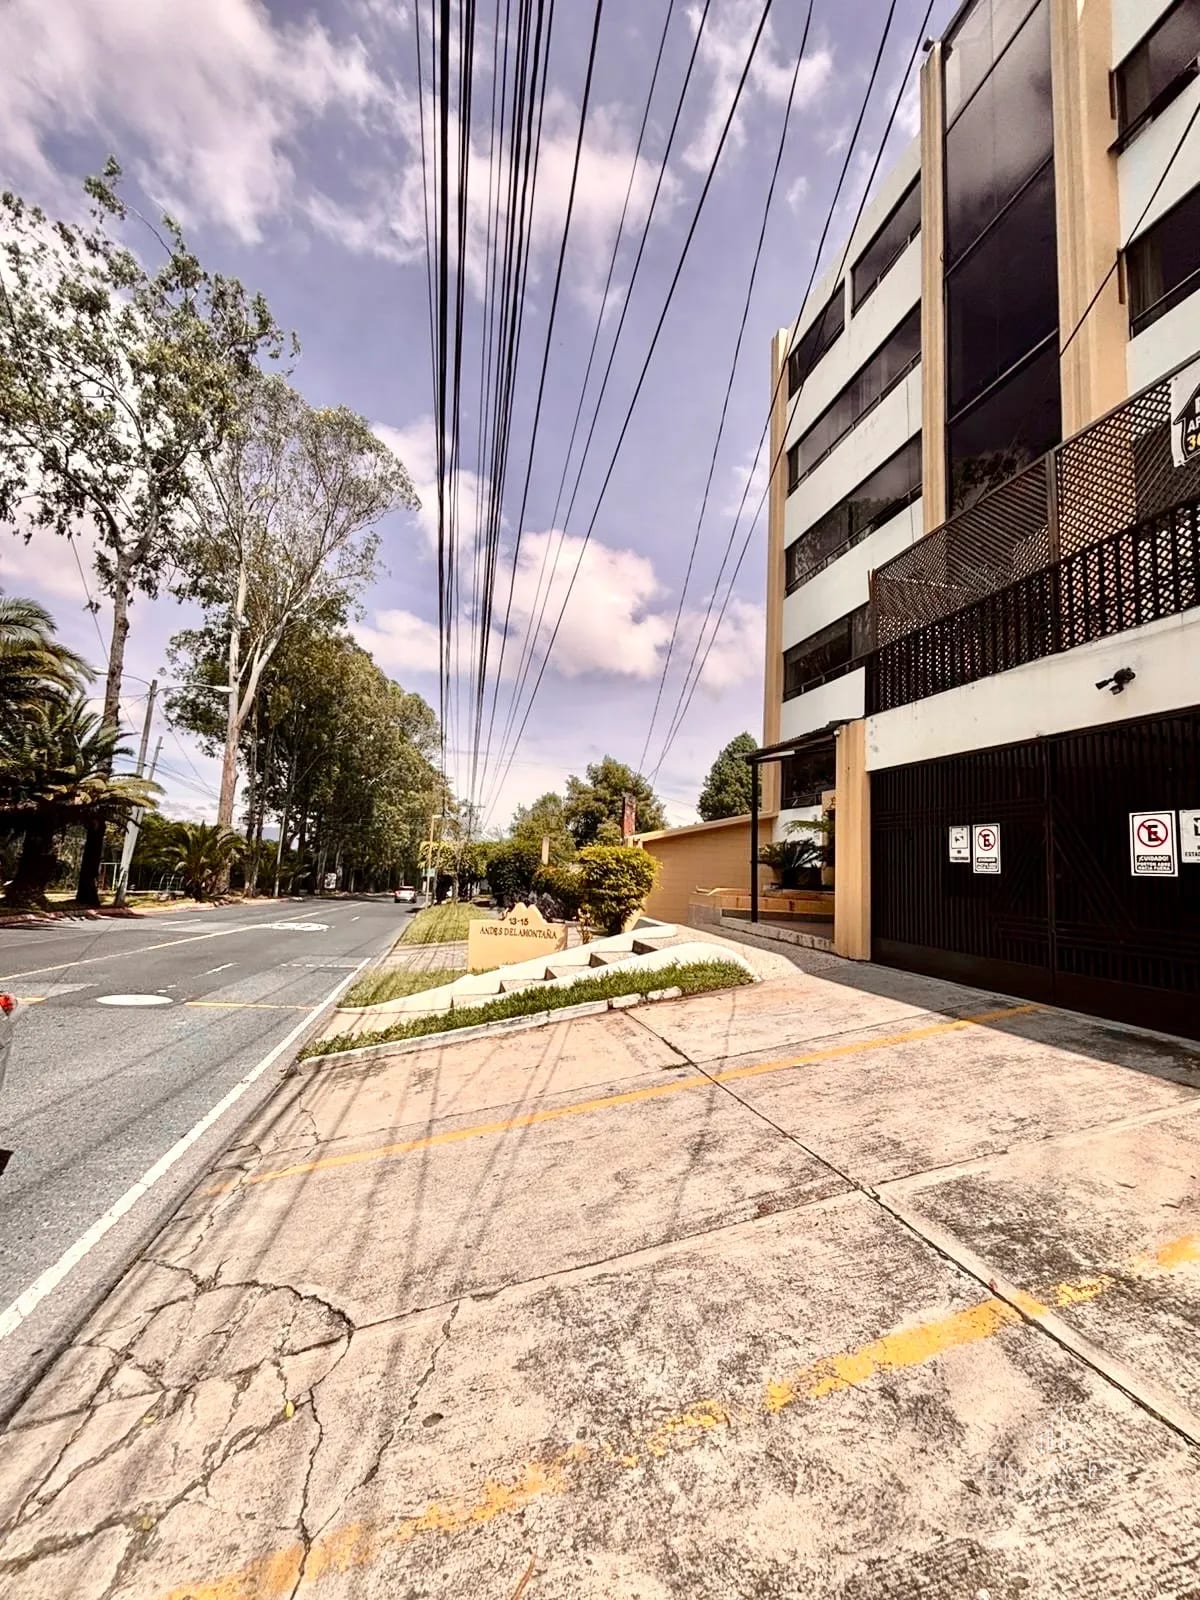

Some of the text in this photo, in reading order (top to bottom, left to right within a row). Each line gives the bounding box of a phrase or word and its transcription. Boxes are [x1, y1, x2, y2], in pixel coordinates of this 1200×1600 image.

[1147, 824, 1158, 841] E
[508, 917, 529, 926] 13-15
[480, 926, 503, 936] ANDES
